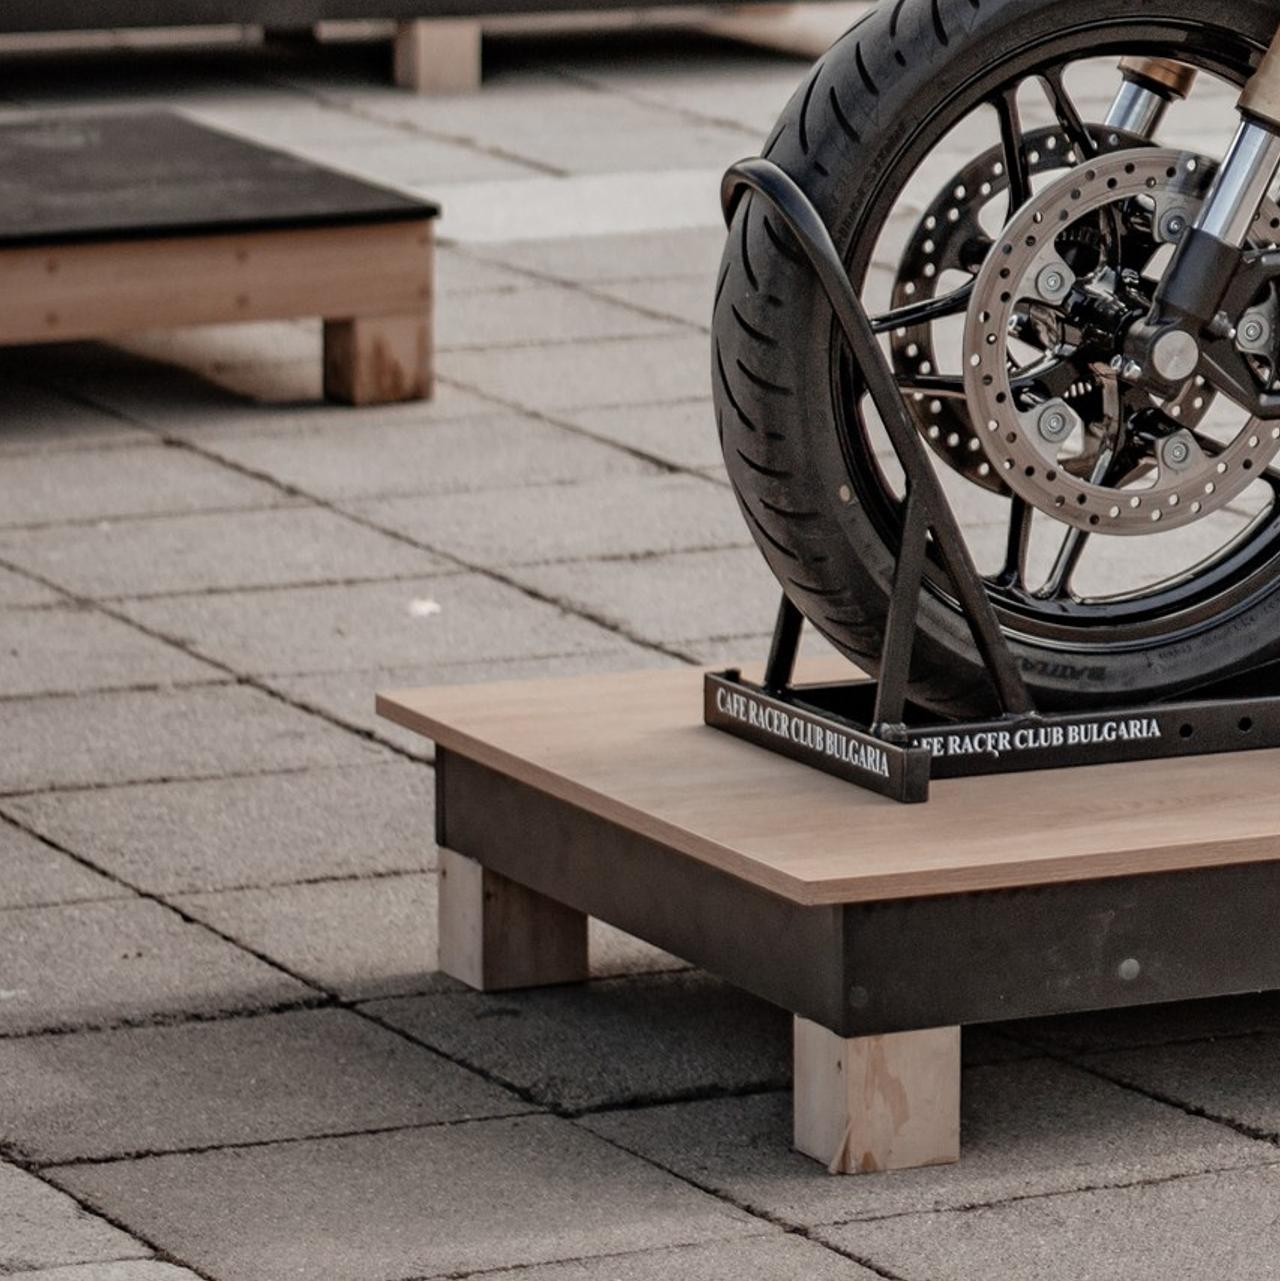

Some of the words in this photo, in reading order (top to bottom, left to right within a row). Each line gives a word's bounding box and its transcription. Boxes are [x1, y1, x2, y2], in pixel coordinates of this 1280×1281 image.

[717, 687, 747, 721] CAFE
[749, 700, 790, 739] RACER
[791, 717, 824, 751] CLUB
[826, 729, 890, 777] BULGARIA
[949, 729, 1012, 756] RACER
[1014, 726, 1064, 749] CLUB
[1067, 719, 1161, 745] BULGARIA
